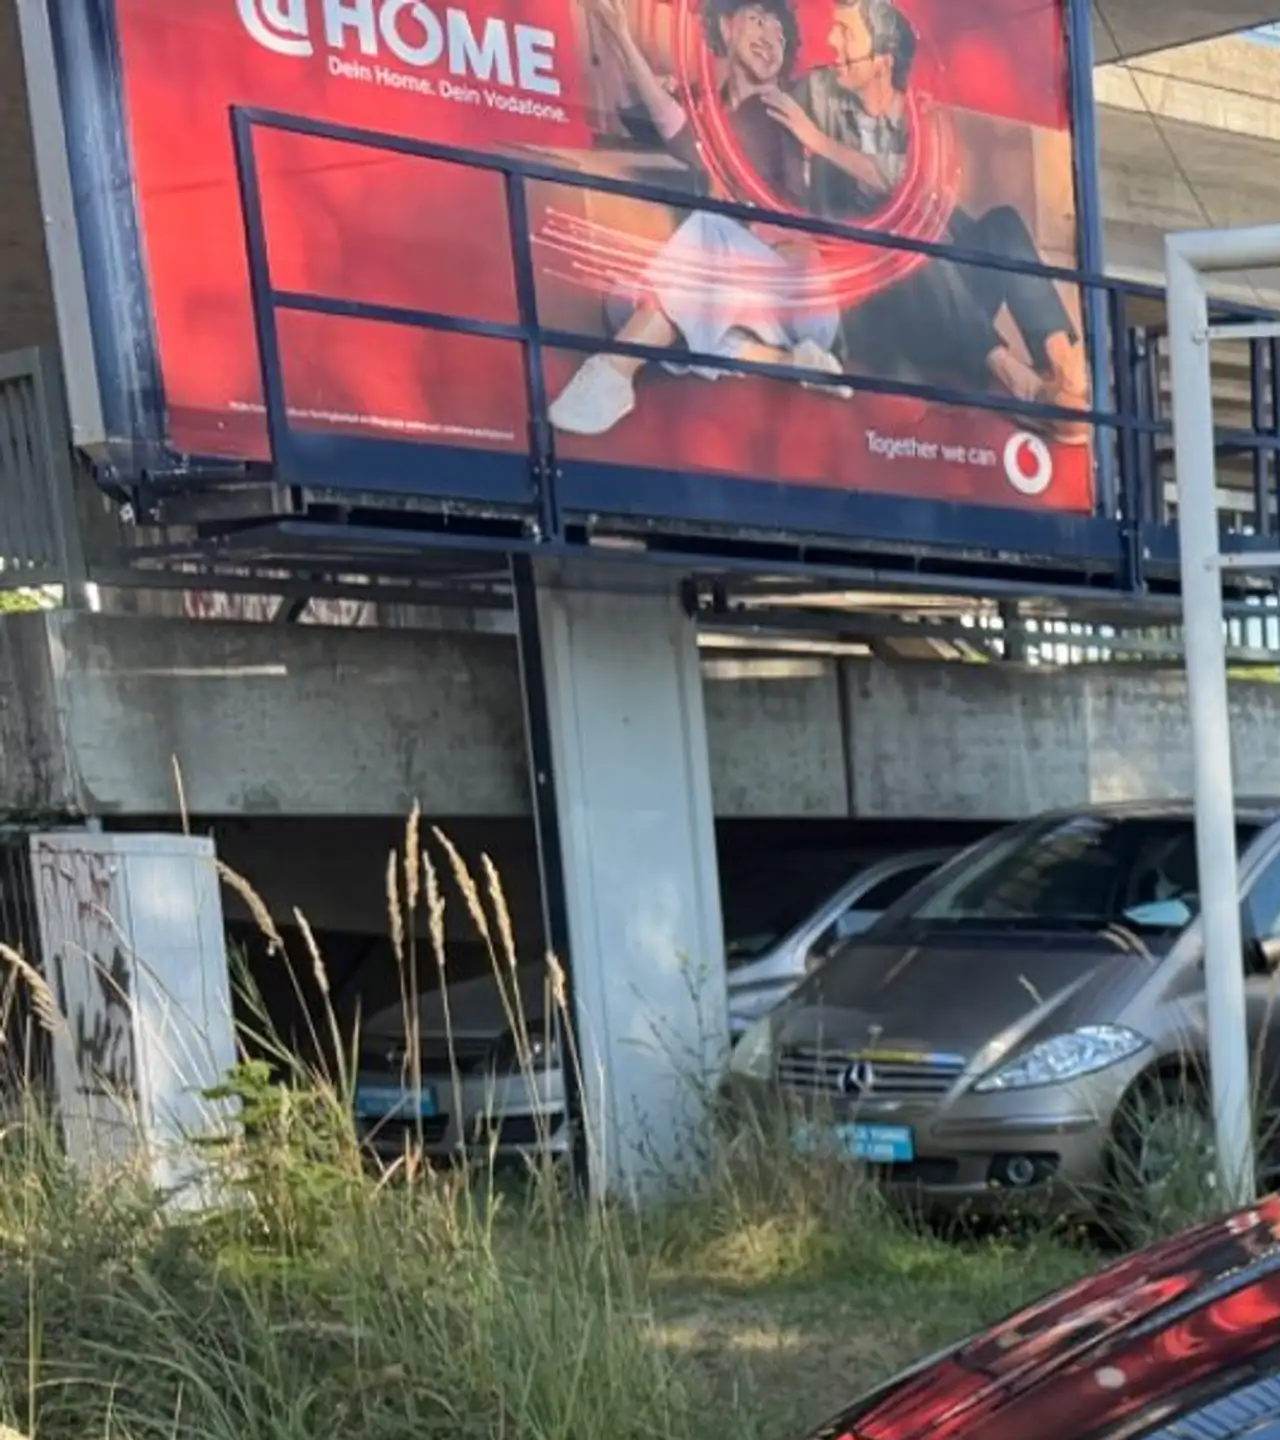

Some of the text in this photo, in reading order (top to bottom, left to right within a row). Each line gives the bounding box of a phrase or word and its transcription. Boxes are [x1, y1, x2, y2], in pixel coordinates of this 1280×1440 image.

[328, 55, 570, 123] Dein Home. Dein Vodafone.
[865, 429, 996, 466] Together we can
